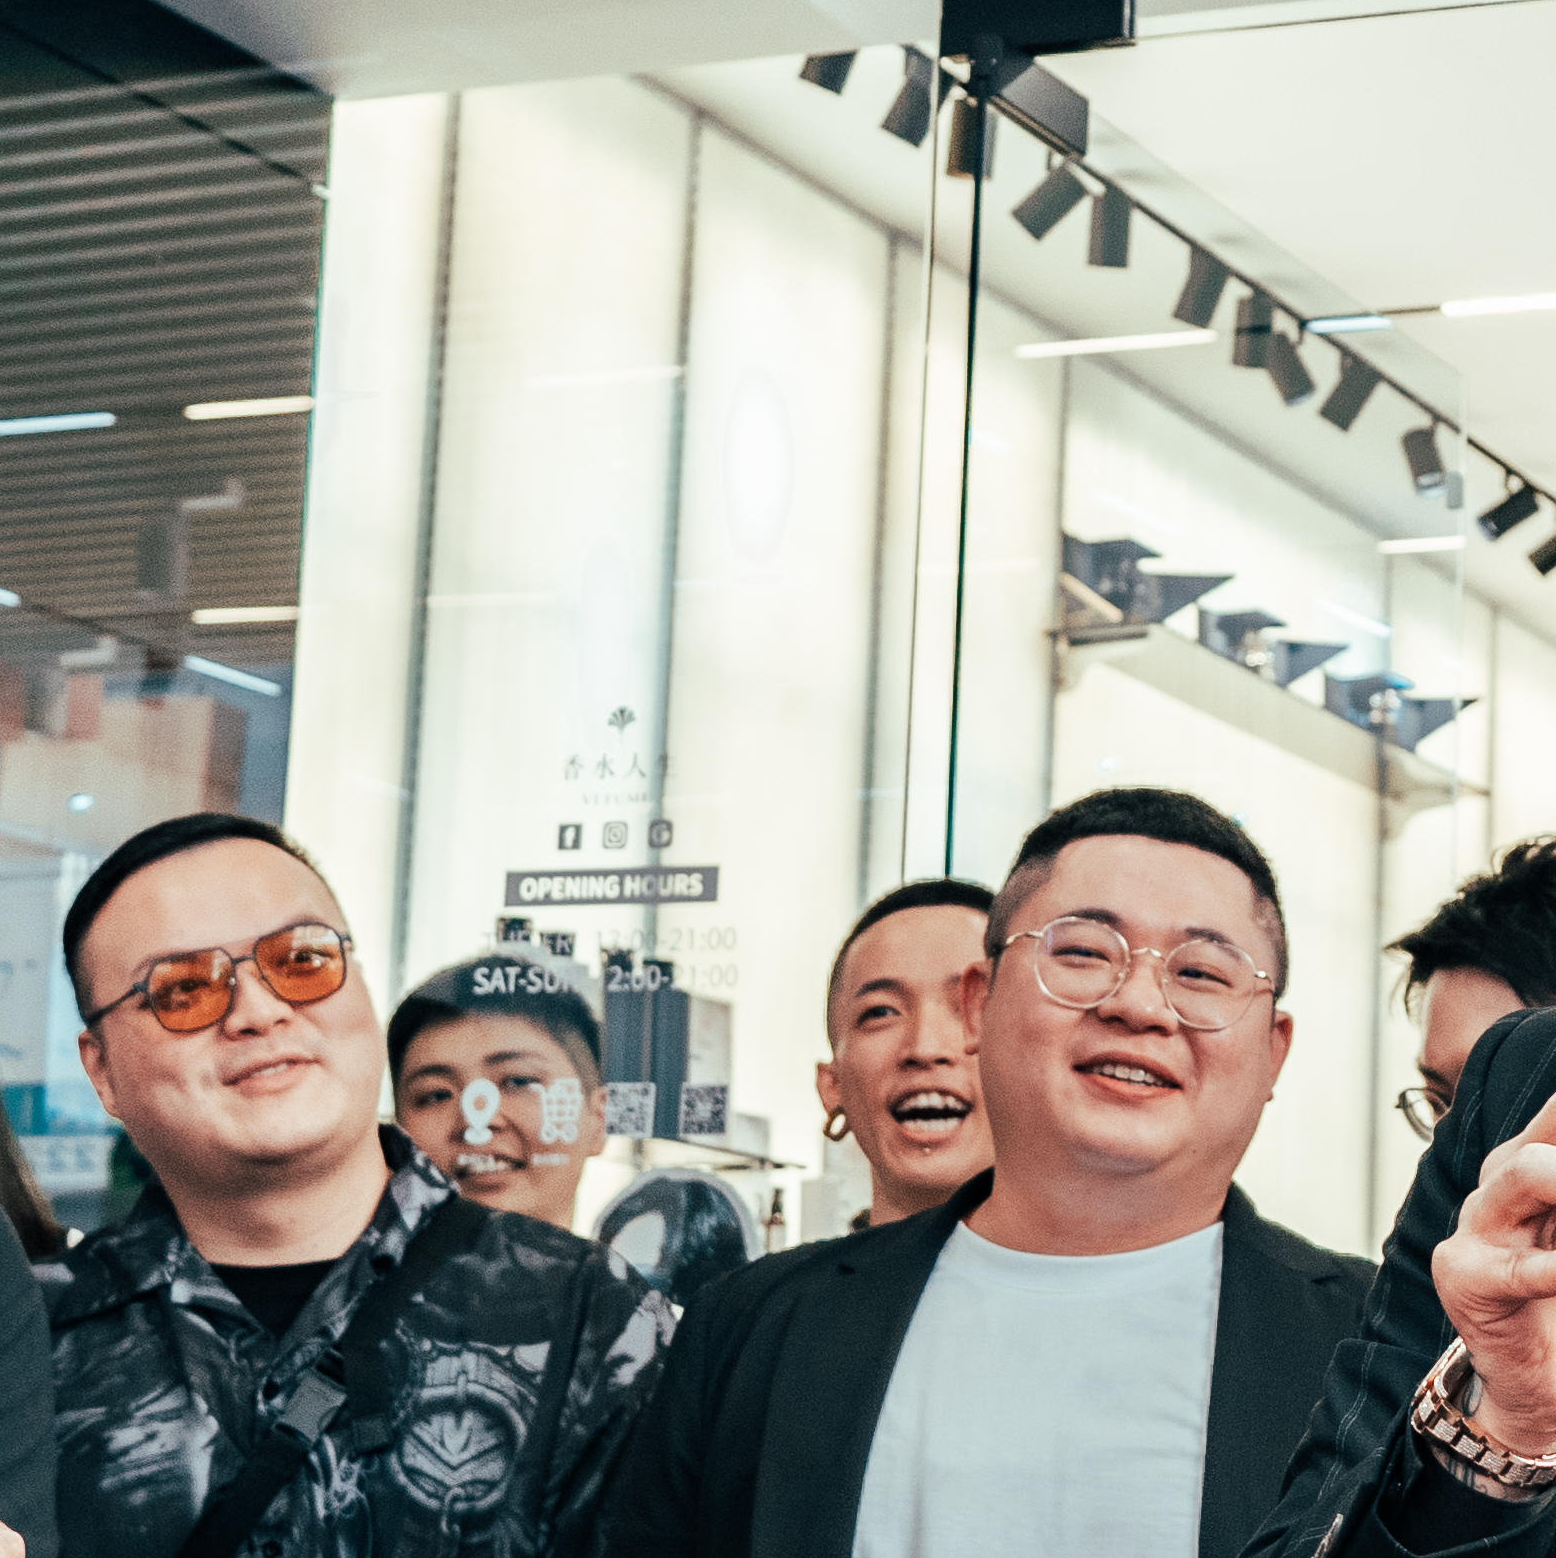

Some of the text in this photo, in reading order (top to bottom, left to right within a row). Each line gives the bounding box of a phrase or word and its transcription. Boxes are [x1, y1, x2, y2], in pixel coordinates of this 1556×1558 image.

[519, 873, 705, 902] OPENING HOURS
[604, 963, 738, 993] 2:00-21:00
